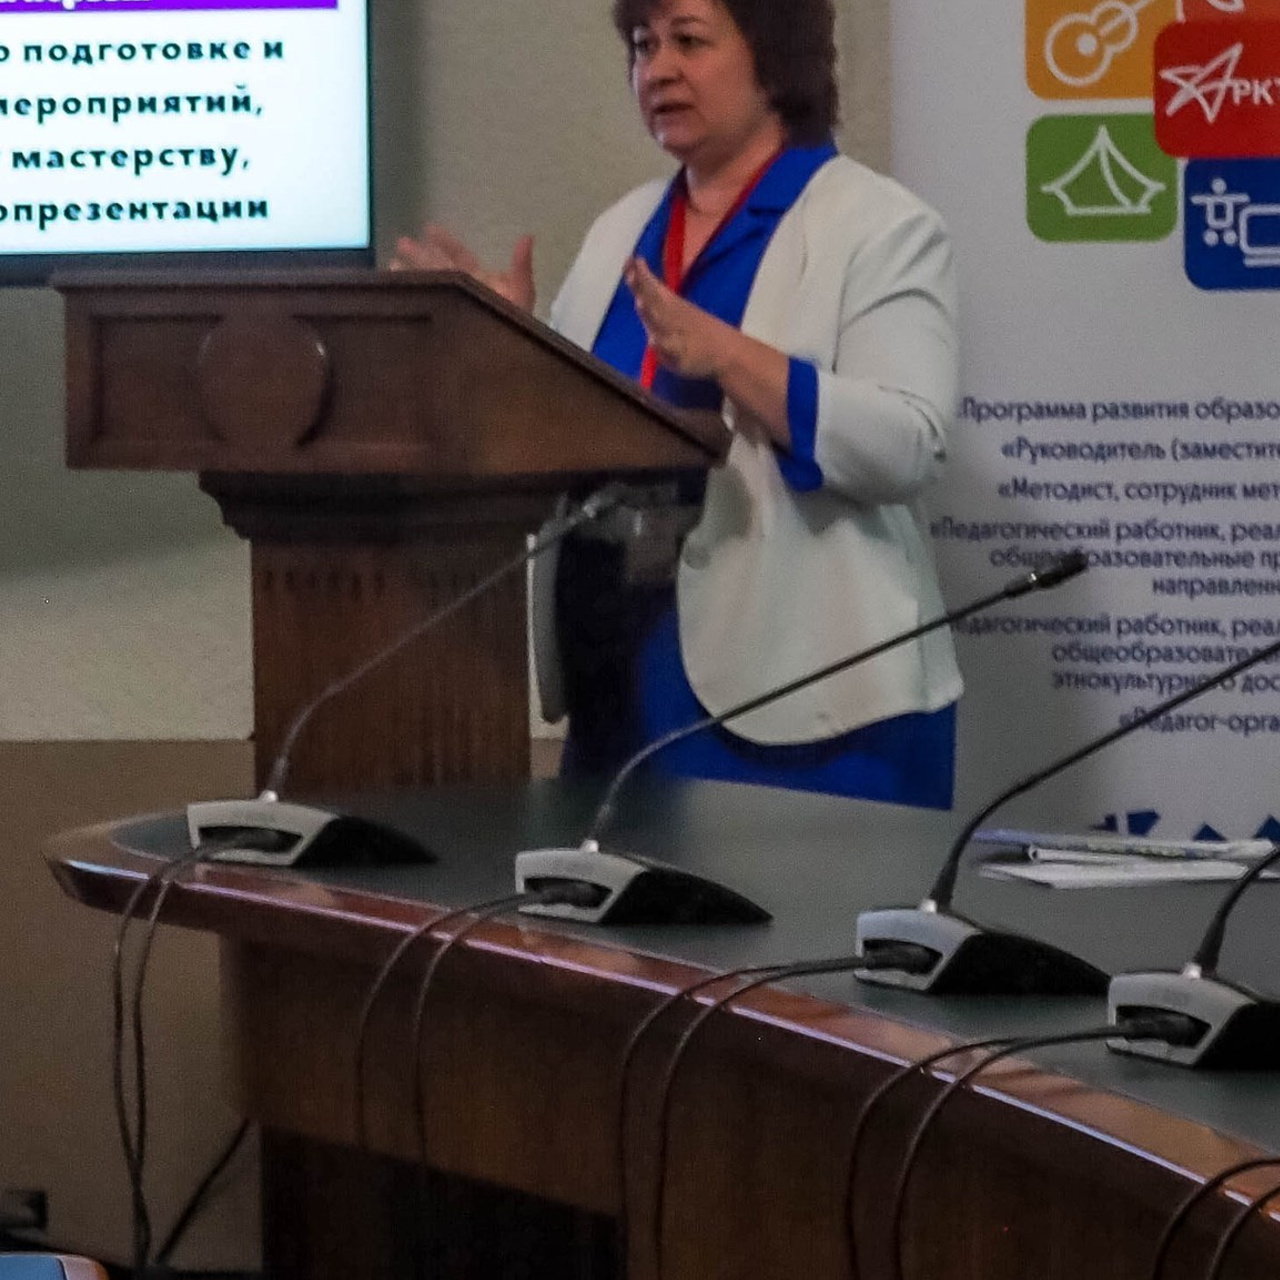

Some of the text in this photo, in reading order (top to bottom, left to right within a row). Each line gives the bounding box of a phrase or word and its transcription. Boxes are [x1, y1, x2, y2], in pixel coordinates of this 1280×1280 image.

[23, 41, 251, 66] подготовке
[263, 41, 284, 60] и
[12, 147, 249, 176] мастерству,
[961, 396, 1280, 424] Программа развития образо
[1172, 437, 1280, 461] (заместит
[1124, 482, 1237, 505] сотрудник
[1232, 523, 1280, 546] реа
[1232, 619, 1280, 640] реа
